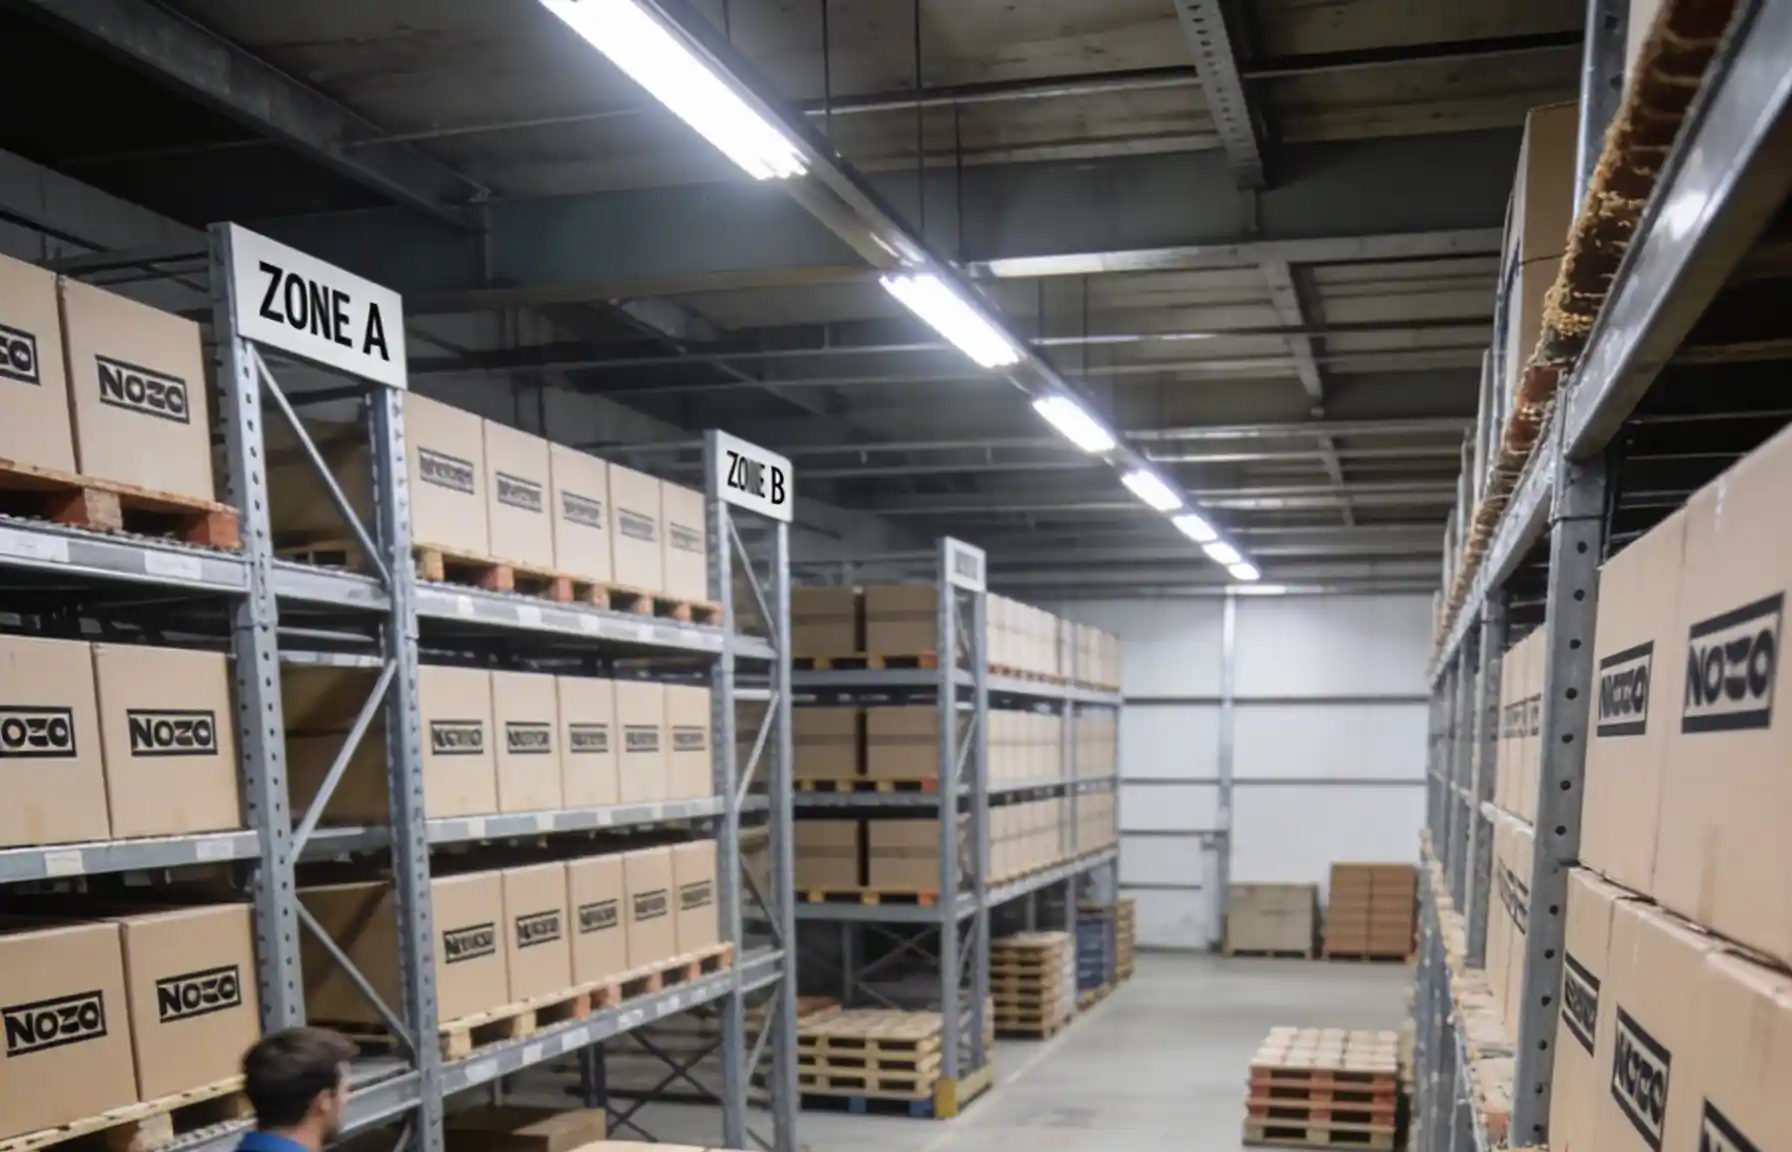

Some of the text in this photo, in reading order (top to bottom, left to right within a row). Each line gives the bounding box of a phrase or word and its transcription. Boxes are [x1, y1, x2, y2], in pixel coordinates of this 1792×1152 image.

[258, 260, 391, 361] ZONE A
[99, 360, 185, 415] NOZO
[771, 466, 785, 505] B
[1687, 629, 1774, 706] NOZO
[0, 717, 69, 748] OZO
[129, 717, 213, 749] NOZO
[158, 973, 239, 1016] NOZO
[4, 1000, 101, 1048] NOZO
